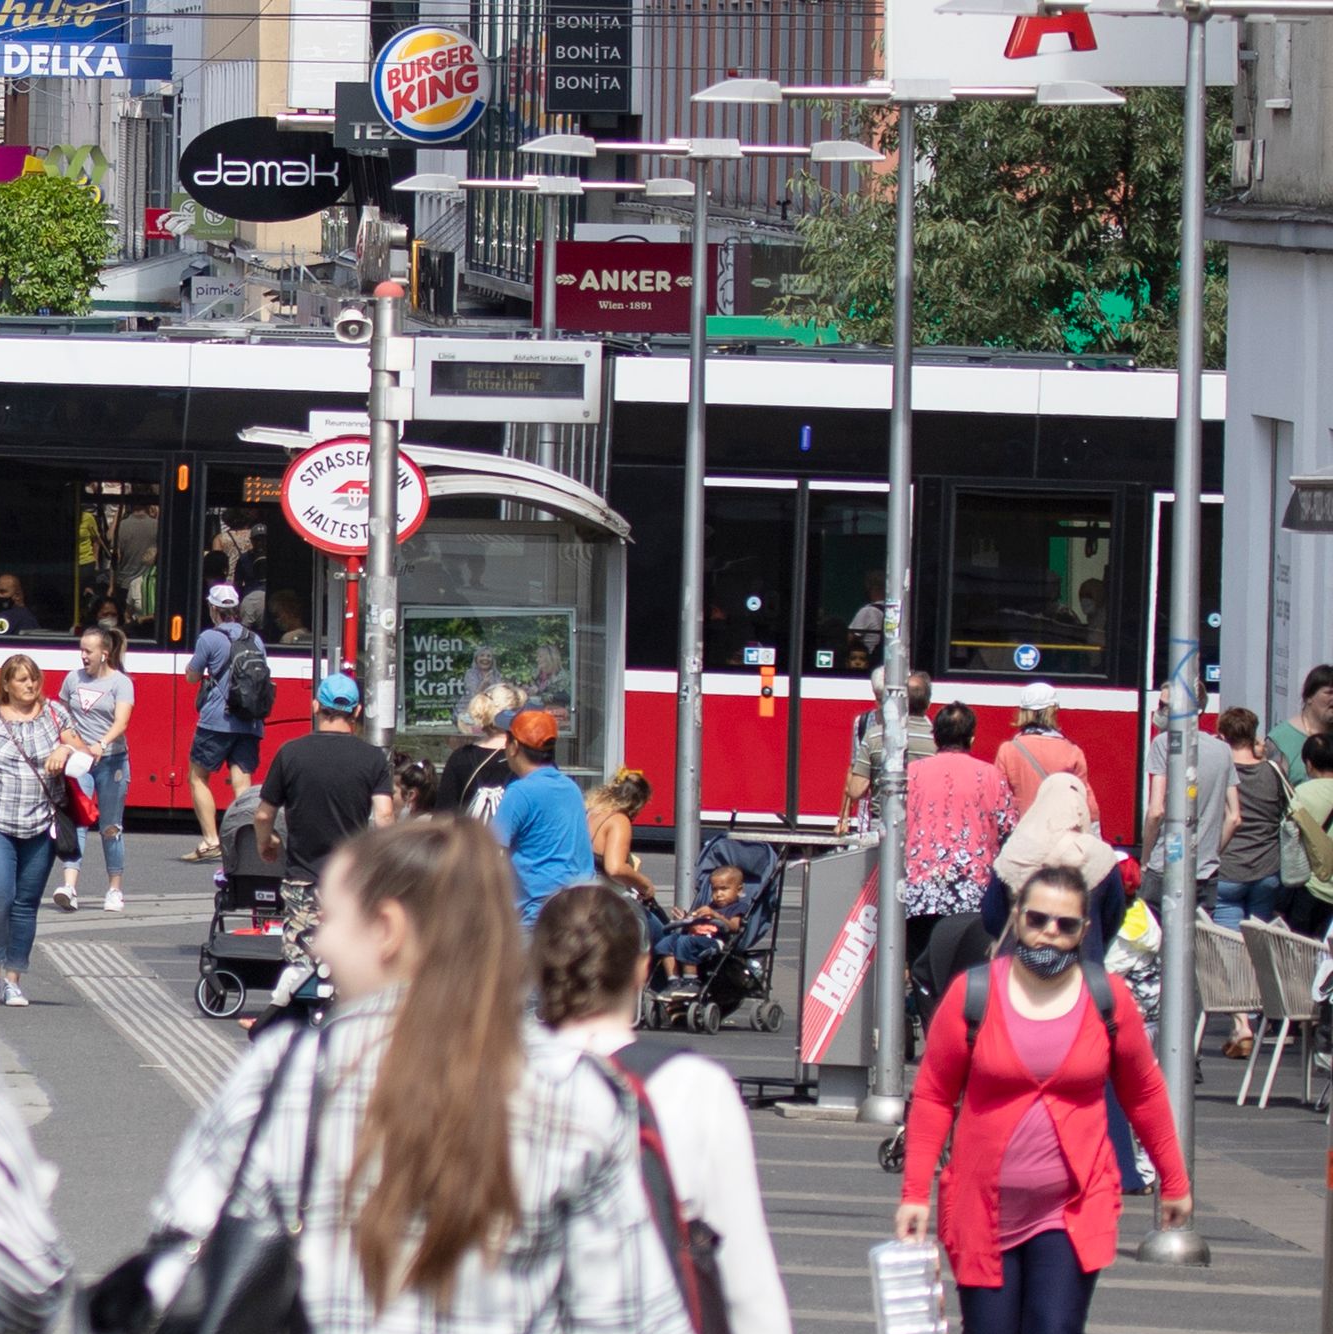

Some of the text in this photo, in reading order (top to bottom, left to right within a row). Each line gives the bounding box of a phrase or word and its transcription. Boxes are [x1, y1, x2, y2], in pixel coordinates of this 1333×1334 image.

[3, 43, 125, 77] DELKA
[387, 44, 475, 92] BURGER
[392, 64, 480, 121] KING
[579, 269, 672, 292] ANKER
[412, 634, 463, 652] Wien
[413, 653, 454, 677] gibt
[414, 677, 470, 696] Kraft.
[809, 904, 878, 1012] Heute
